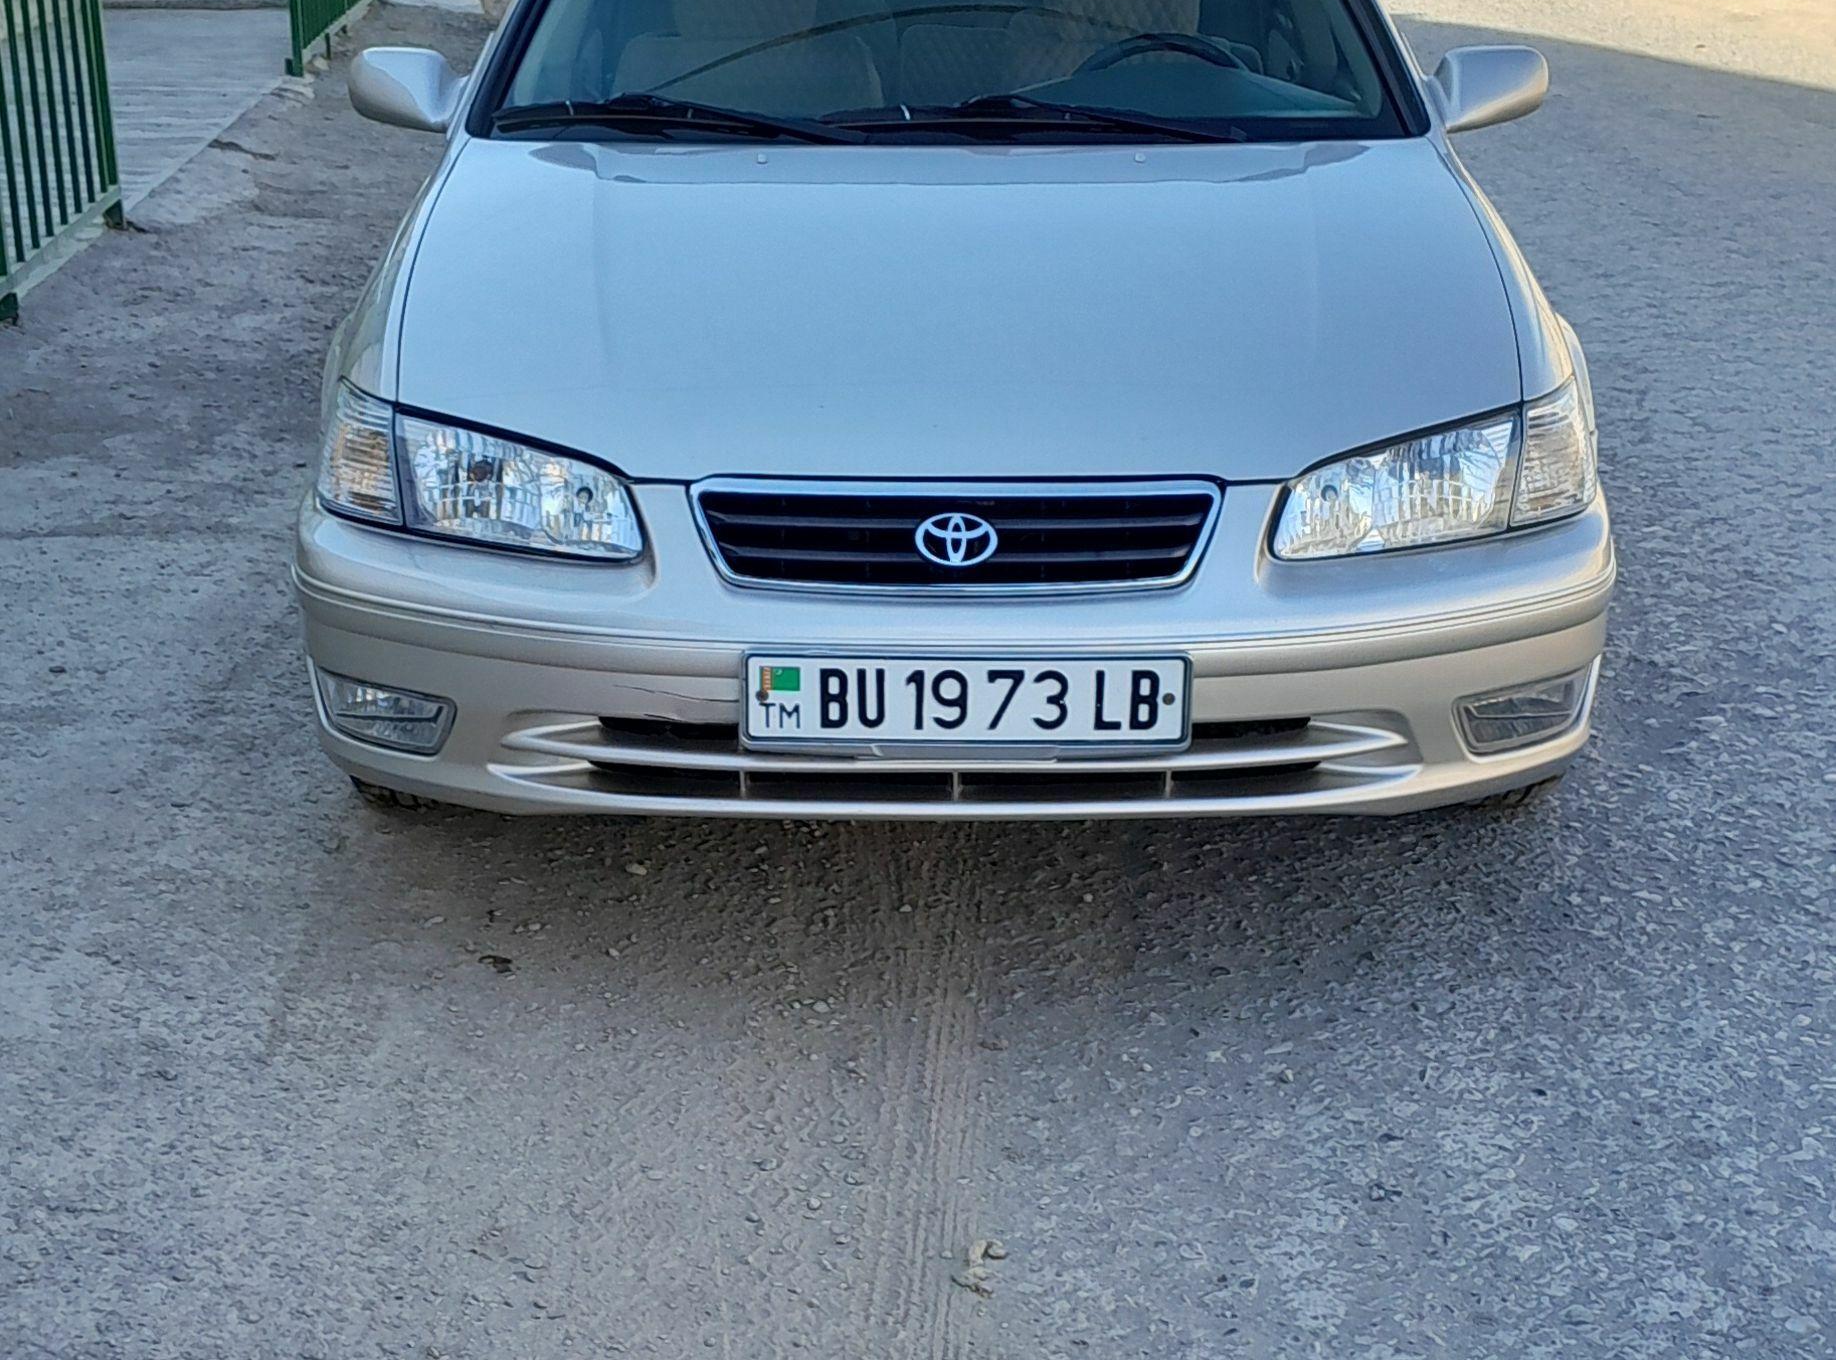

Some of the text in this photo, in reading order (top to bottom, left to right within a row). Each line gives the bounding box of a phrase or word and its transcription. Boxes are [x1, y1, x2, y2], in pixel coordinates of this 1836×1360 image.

[759, 702, 800, 729] TM
[819, 668, 885, 730] BU
[1093, 670, 1160, 731] LB
